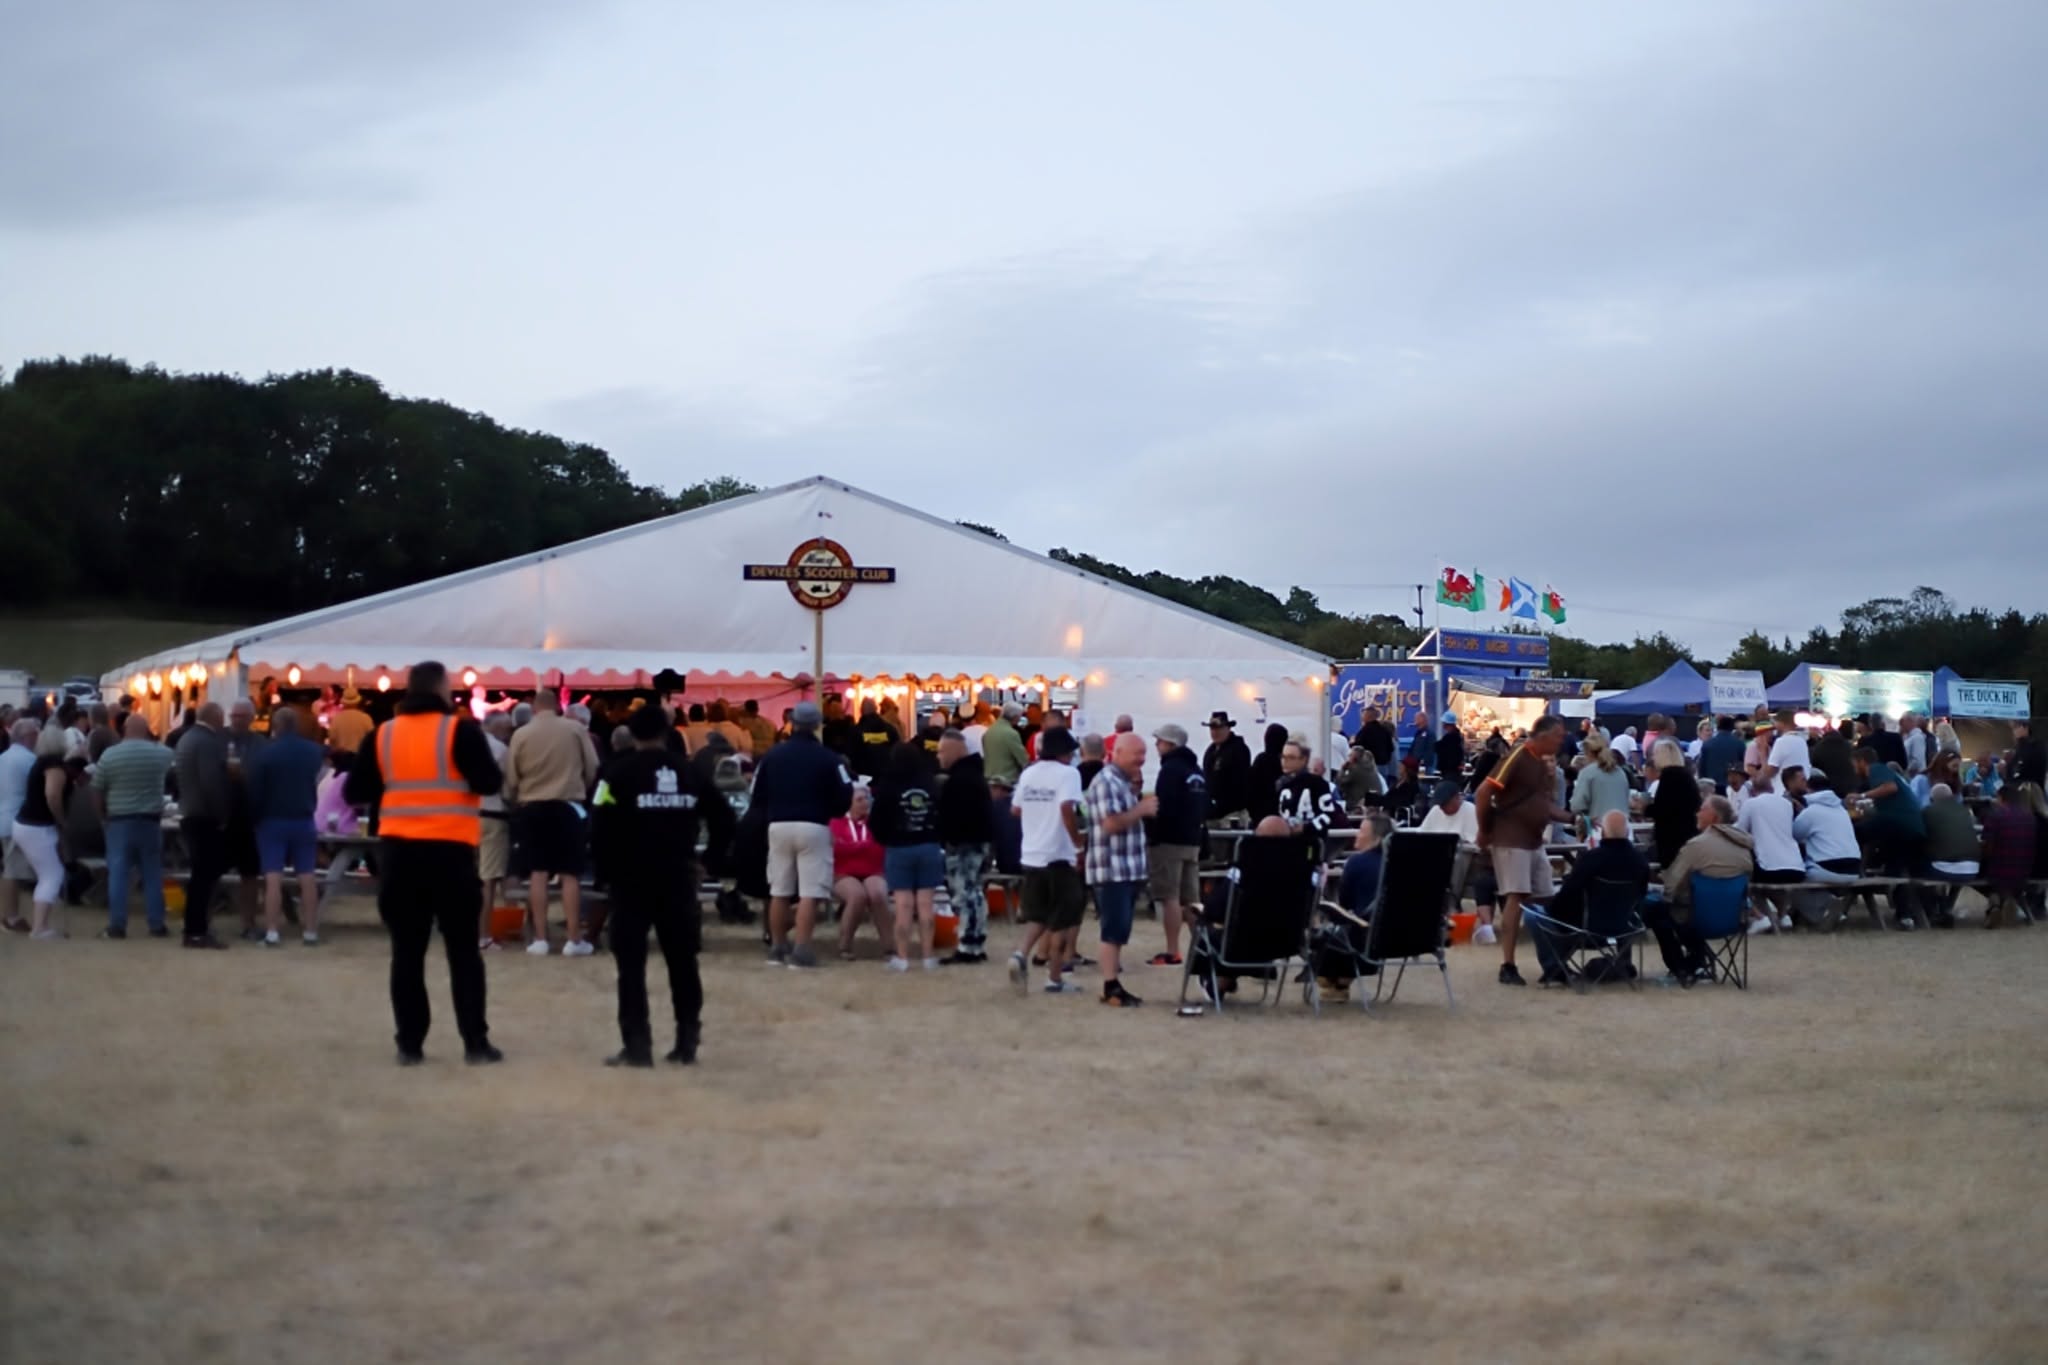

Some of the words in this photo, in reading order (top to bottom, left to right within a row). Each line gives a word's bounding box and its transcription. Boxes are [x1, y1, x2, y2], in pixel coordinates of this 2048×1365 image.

[751, 566, 801, 578] DEVIZES
[805, 567, 858, 579] SCOOTER
[861, 569, 889, 580] CLUB
[1372, 690, 1420, 707] CATC
[1957, 688, 1975, 702] THE
[1977, 689, 2000, 704] DUCK
[2002, 690, 2017, 705] HUT
